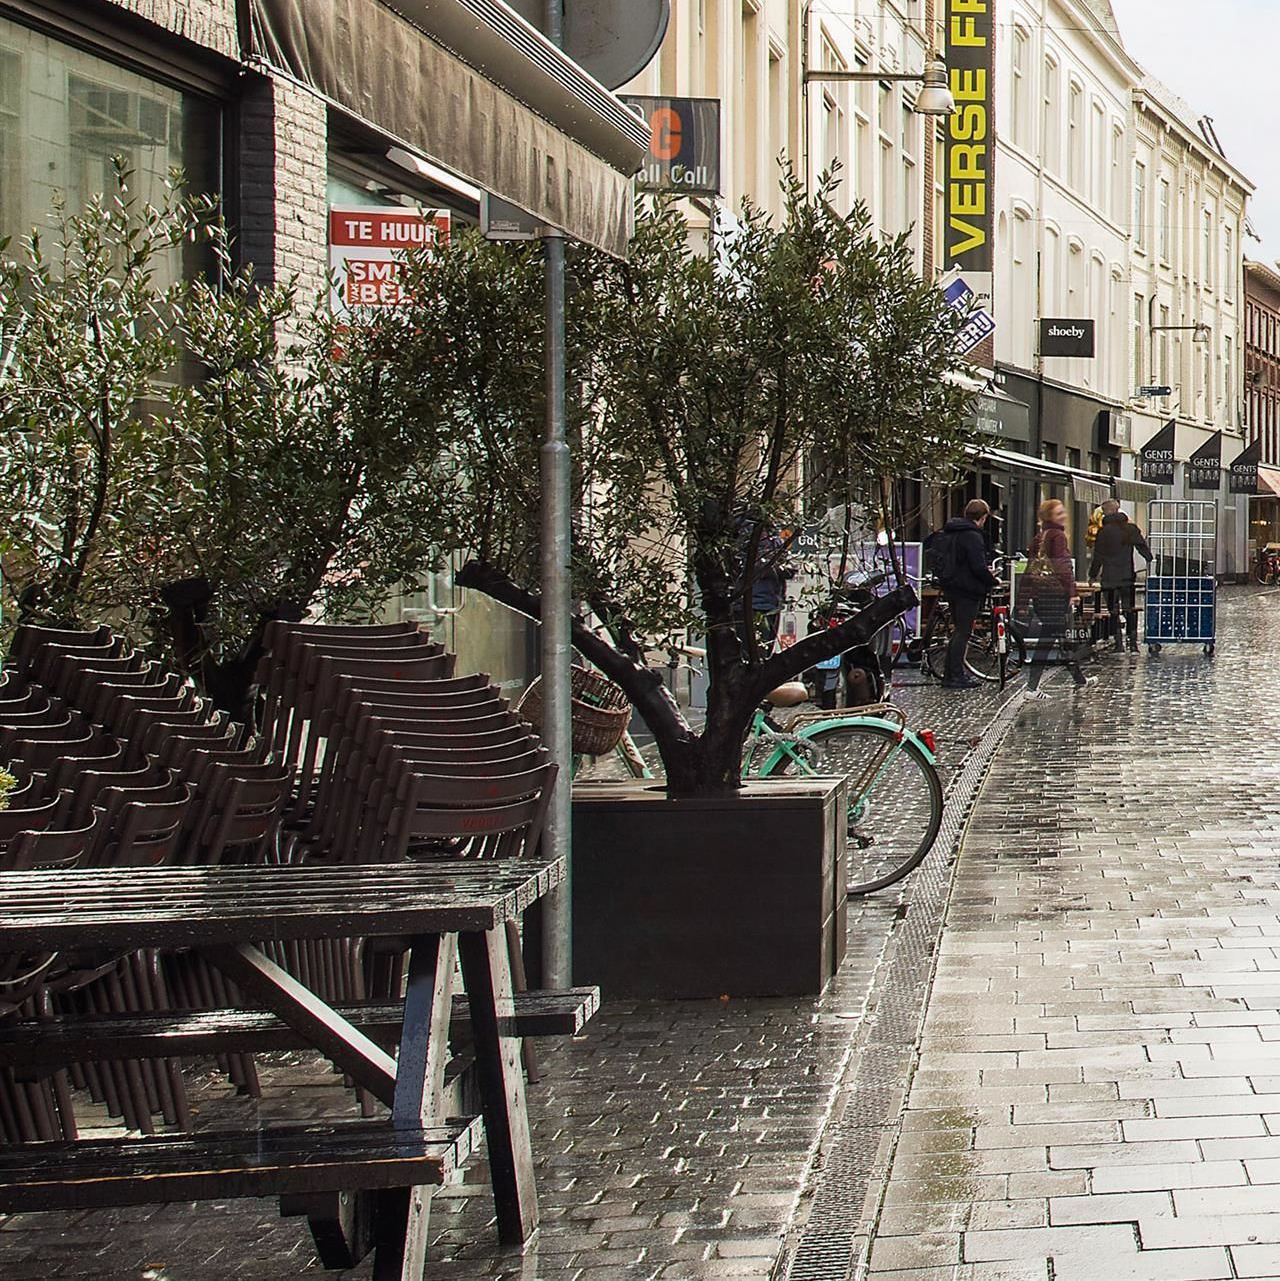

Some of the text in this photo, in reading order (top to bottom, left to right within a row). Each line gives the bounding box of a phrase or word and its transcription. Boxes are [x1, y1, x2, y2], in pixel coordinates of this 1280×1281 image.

[950, 68, 986, 257] VERSE
[344, 220, 373, 240] TE
[1048, 325, 1085, 339] shoeby
[1144, 450, 1173, 460] GENTS
[1193, 458, 1220, 468] GENTS
[1233, 464, 1257, 474] GENTS
